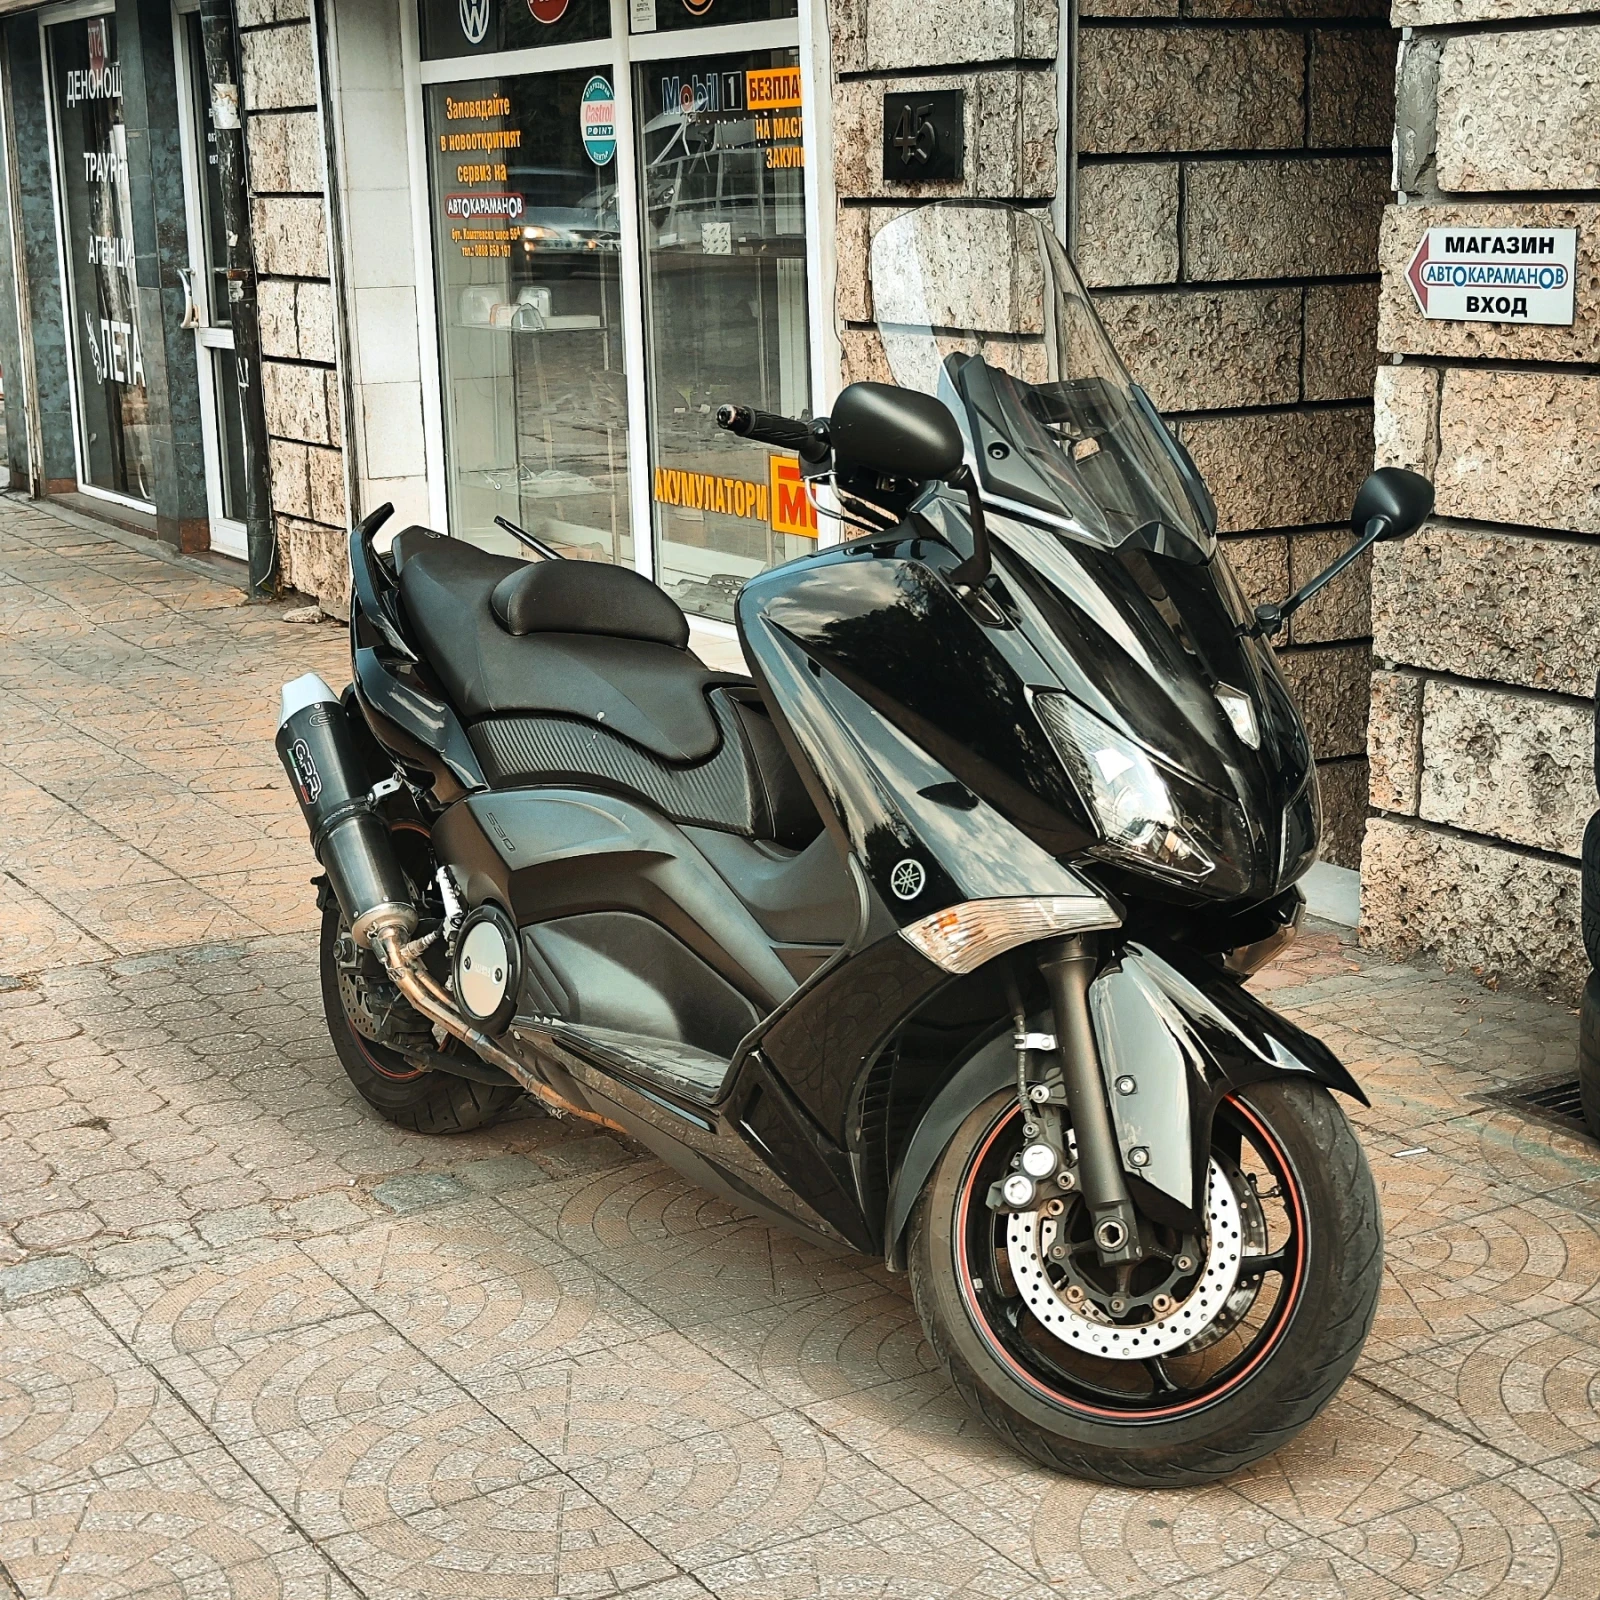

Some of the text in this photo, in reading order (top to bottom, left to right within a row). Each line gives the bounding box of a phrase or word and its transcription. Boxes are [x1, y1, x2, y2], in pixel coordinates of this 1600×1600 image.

[661, 74, 719, 116] Mobil
[749, 74, 802, 102] БЕЗПЛА
[446, 92, 511, 121] Заповядайте
[585, 104, 613, 124] Castrol
[587, 126, 613, 135] POINT
[756, 118, 771, 140] НА
[893, 103, 936, 165] 45
[449, 130, 521, 155] новооткритият
[83, 152, 129, 183] ТРАУРН
[457, 163, 507, 188] сервиз на
[447, 197, 523, 219] АВТОКАРАМАНОВ
[88, 235, 136, 276] АГЕНЦИ
[1445, 236, 1555, 255] МАГАЗИН
[1426, 265, 1564, 290] АВТОКАРАМАНОВ
[1466, 296, 1528, 318] ВХОД
[100, 318, 147, 388] ЛЕТА
[654, 466, 768, 522] АКУМУЛАТОРИ
[778, 483, 818, 530] M
